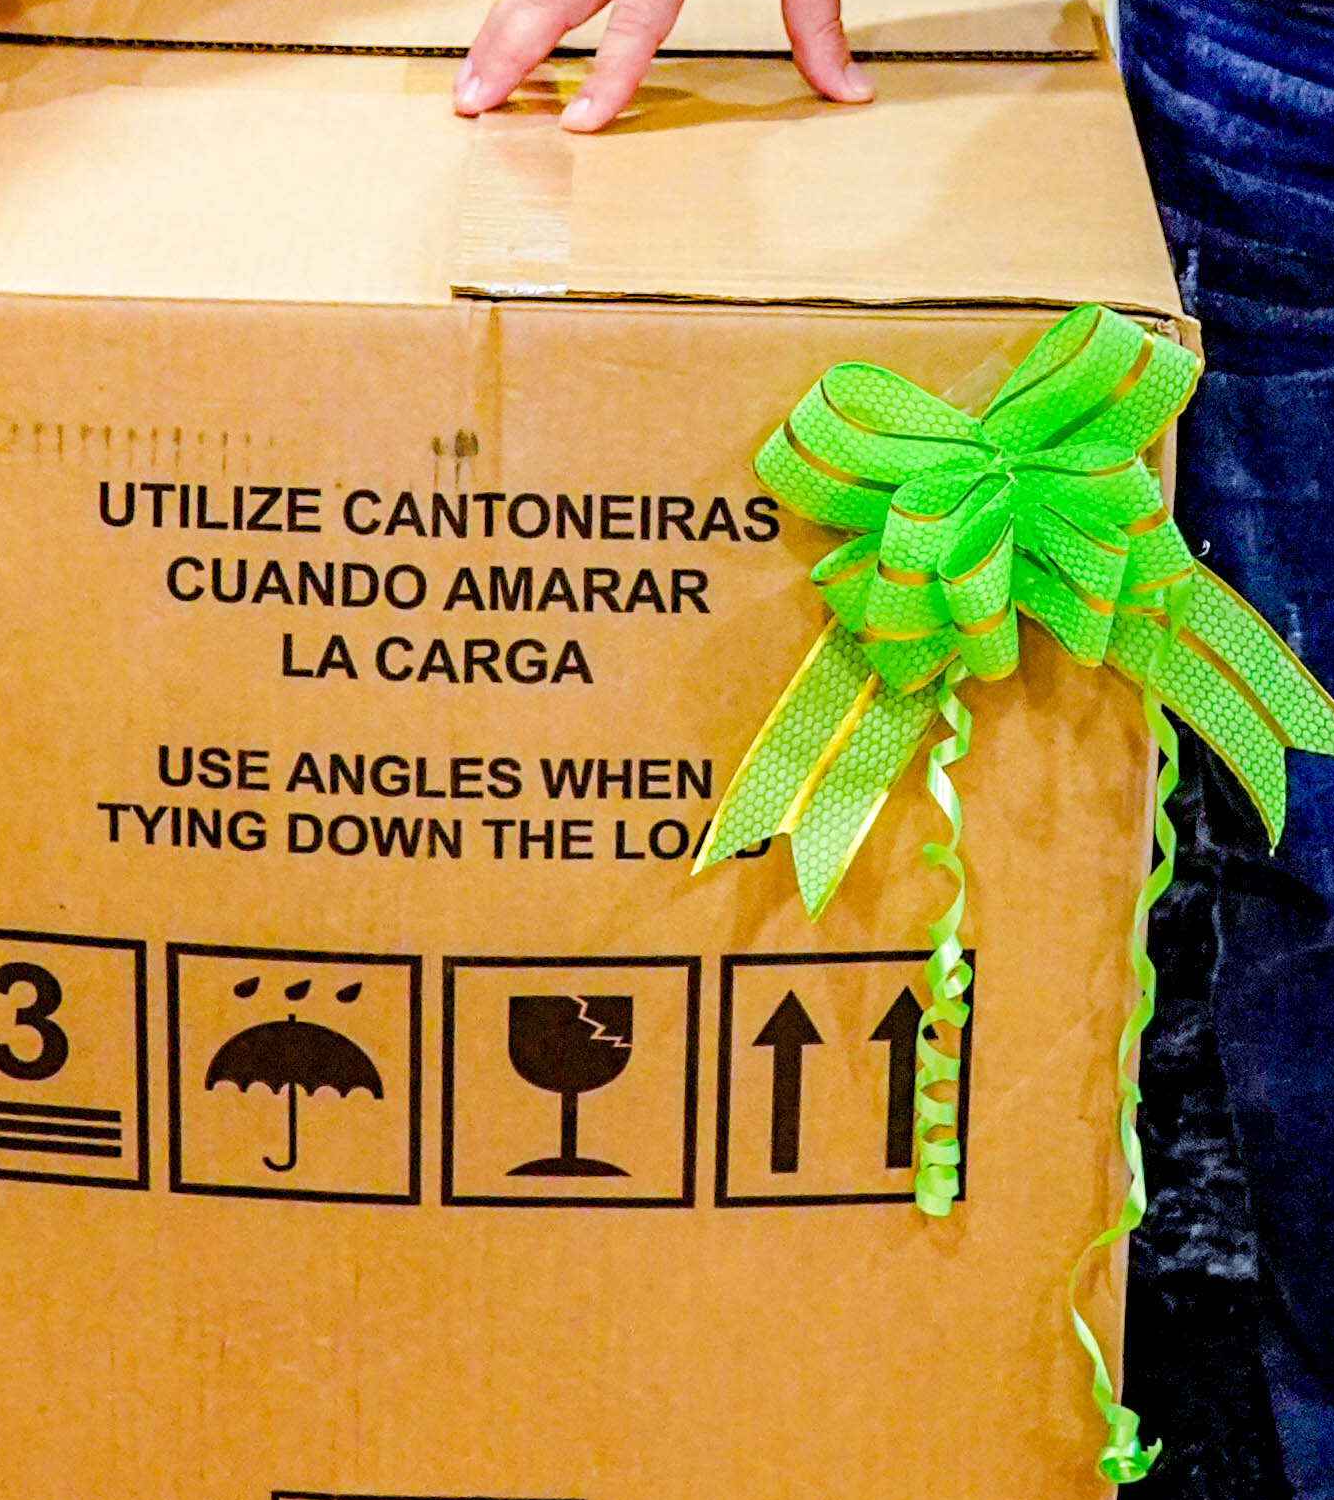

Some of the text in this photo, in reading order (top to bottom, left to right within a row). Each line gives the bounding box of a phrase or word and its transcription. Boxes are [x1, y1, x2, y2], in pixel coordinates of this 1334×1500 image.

[99, 481, 781, 543] UTILIZE CANTONEIRAS
[166, 555, 711, 615] CUANDO AMARAR
[281, 632, 594, 685] LA CARGA
[158, 744, 713, 800] USE ANGLES WHEN
[96, 802, 267, 853] TYING
[287, 812, 463, 859] DOWN
[481, 818, 595, 861] THE
